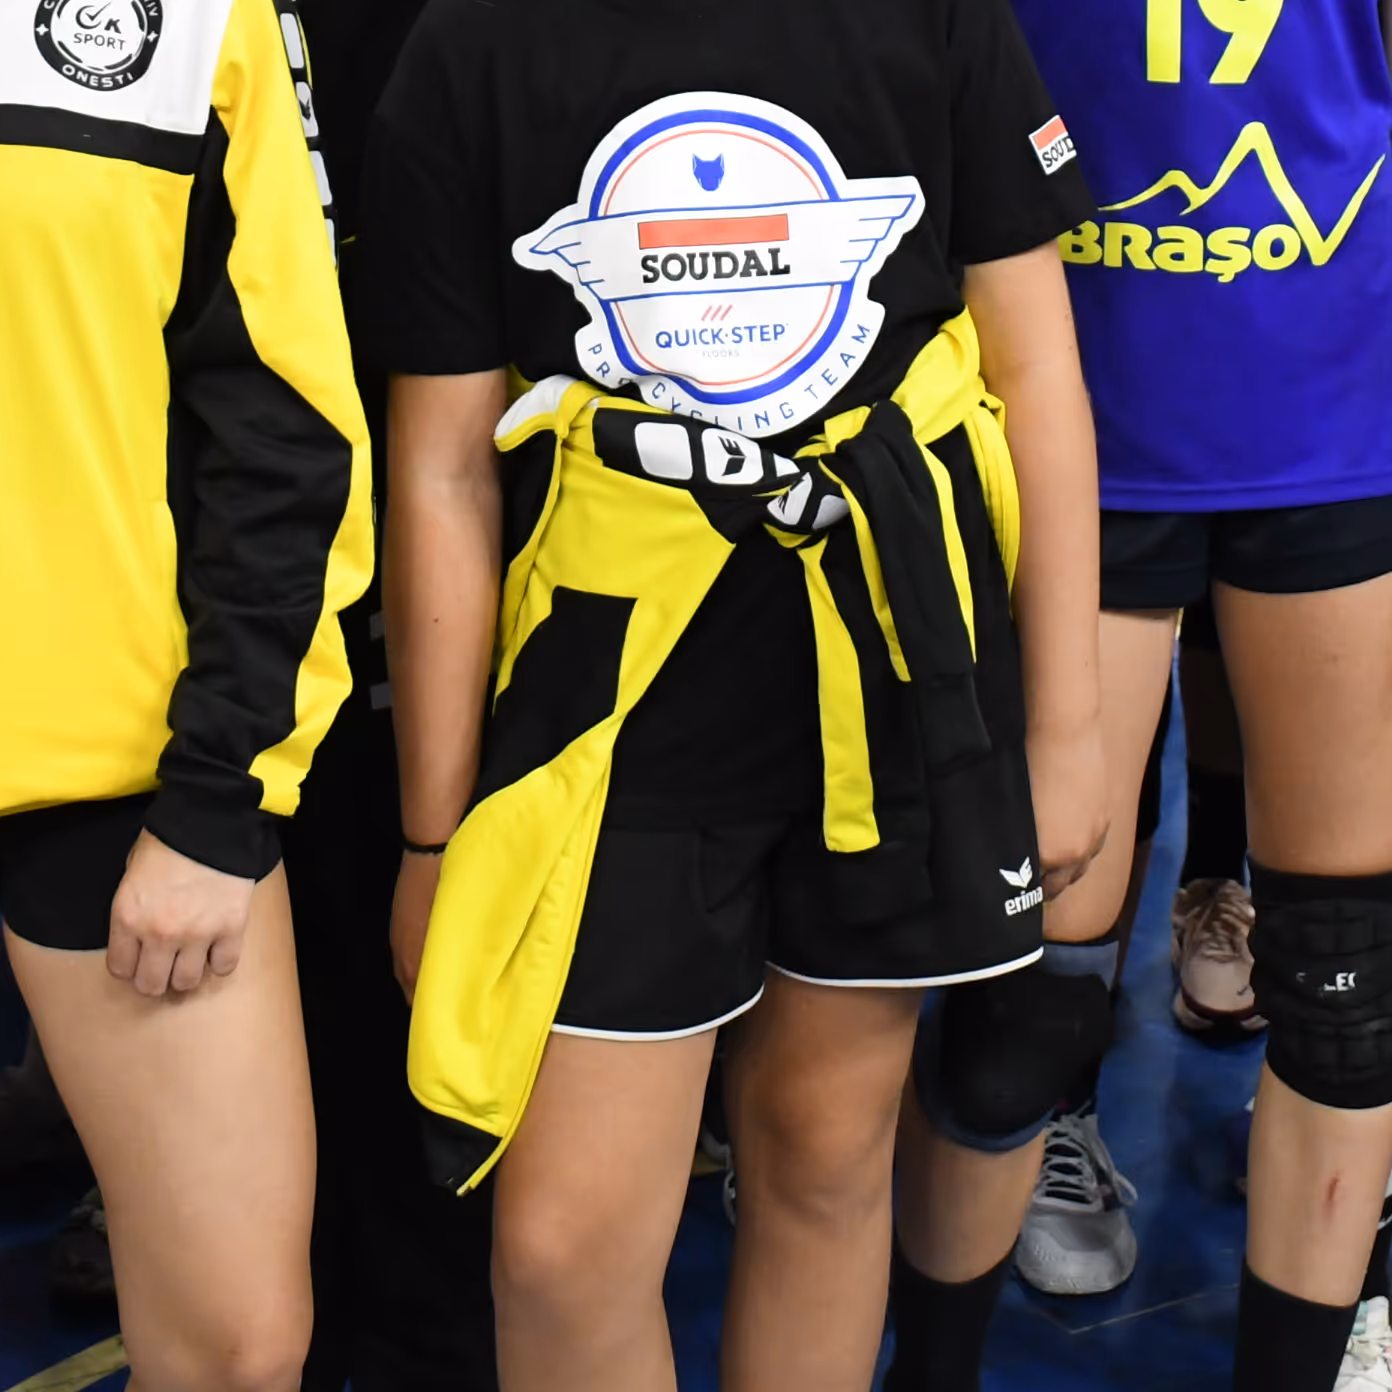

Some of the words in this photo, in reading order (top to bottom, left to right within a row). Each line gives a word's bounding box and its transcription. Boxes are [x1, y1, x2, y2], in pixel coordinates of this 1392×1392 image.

[73, 32, 126, 51] SPORT
[62, 63, 134, 88] ONESTI
[641, 247, 791, 284] SOUDAL
[804, 324, 871, 400] TEAM
[1004, 886, 1044, 916] erima
